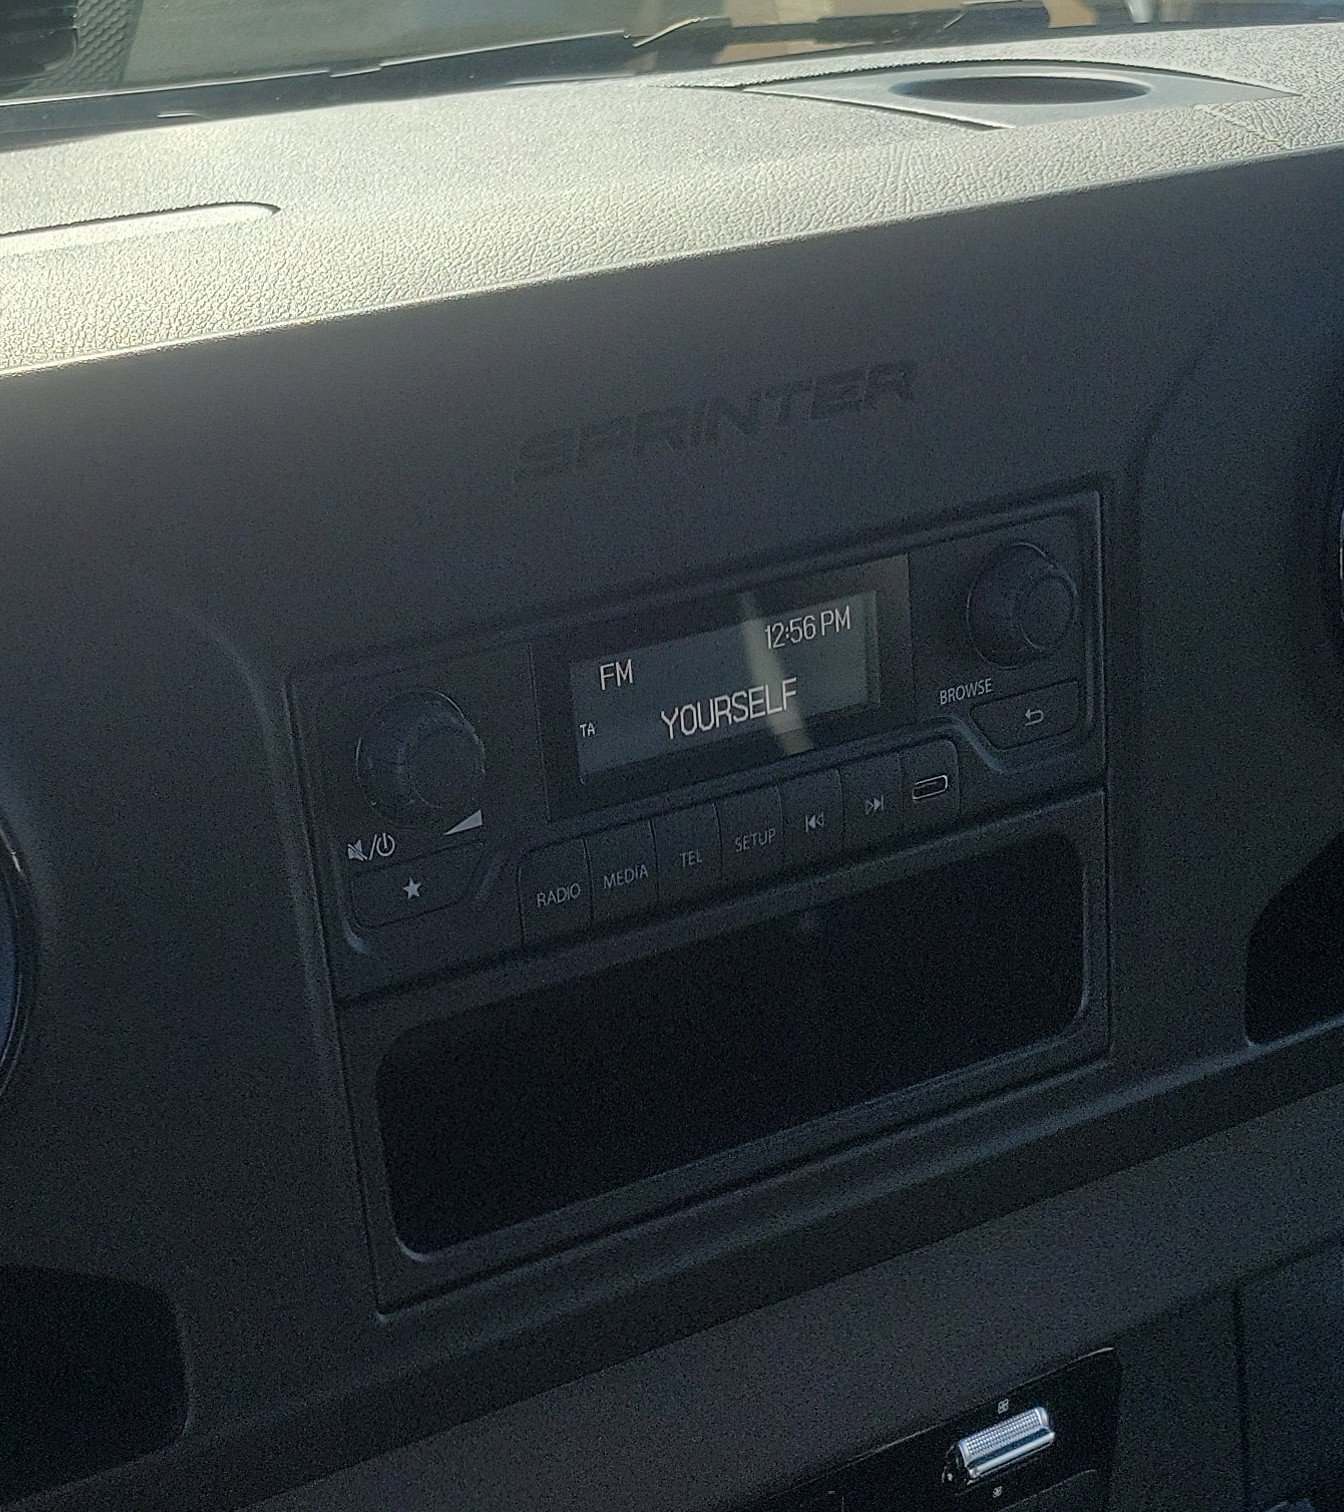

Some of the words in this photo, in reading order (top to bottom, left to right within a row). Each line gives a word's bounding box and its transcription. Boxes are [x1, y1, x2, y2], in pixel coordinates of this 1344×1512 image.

[515, 360, 916, 480] SPRINTER
[765, 614, 817, 650] 12:56
[821, 605, 851, 635] PM
[599, 658, 634, 691] FM
[939, 678, 994, 705] BROWSE
[660, 677, 798, 740] YOURSELF
[579, 721, 596, 738] TA
[734, 827, 778, 853] SETUP
[679, 851, 703, 868] TEL
[603, 863, 649, 889] MEDIA
[536, 882, 582, 908] RADIO
